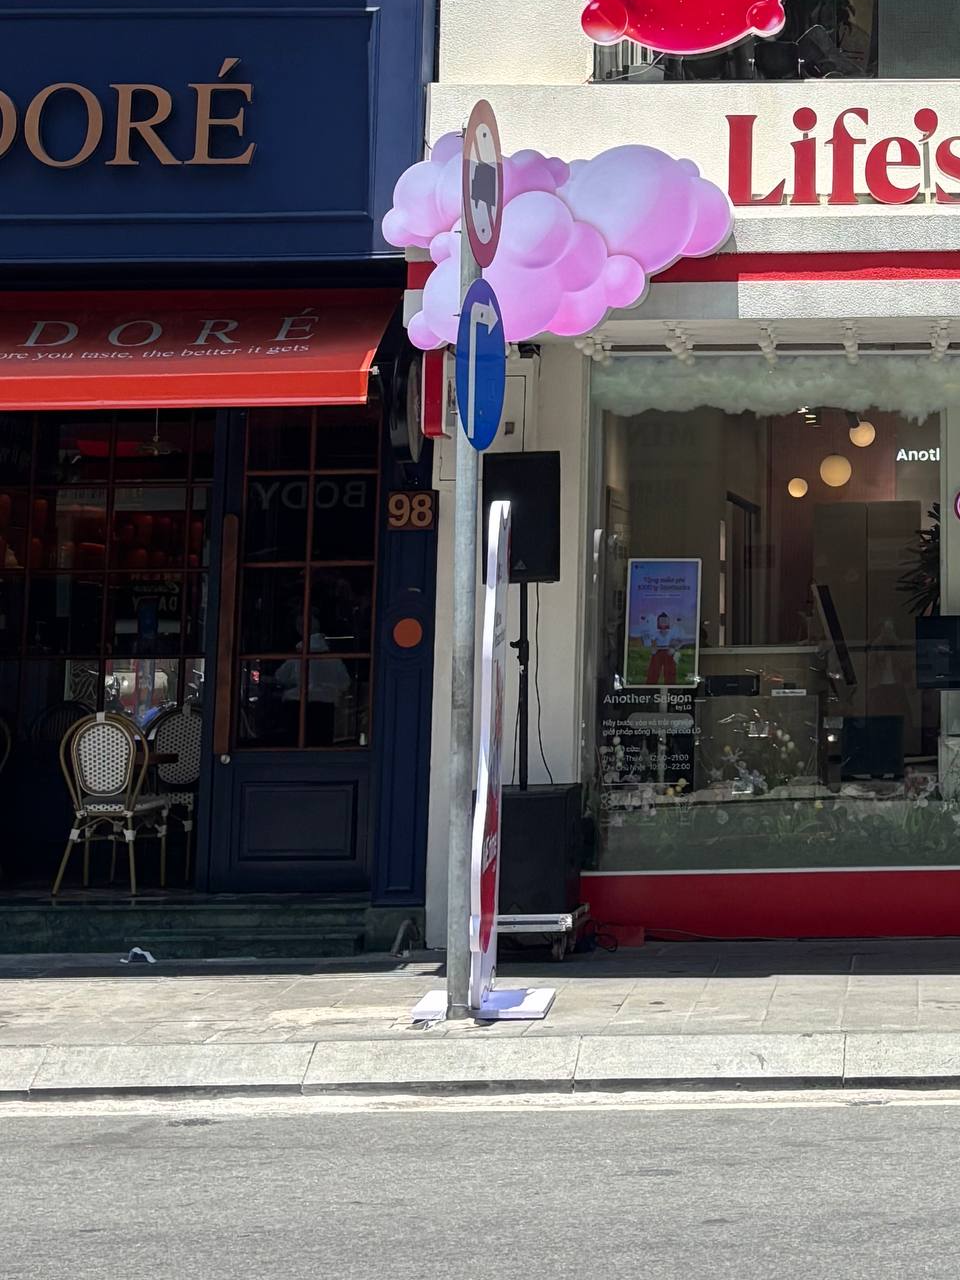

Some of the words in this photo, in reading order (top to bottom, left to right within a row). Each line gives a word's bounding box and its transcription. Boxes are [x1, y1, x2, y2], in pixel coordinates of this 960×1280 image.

[0, 58, 257, 169] ORÉ
[388, 493, 432, 528] 98
[603, 693, 651, 704] Another
